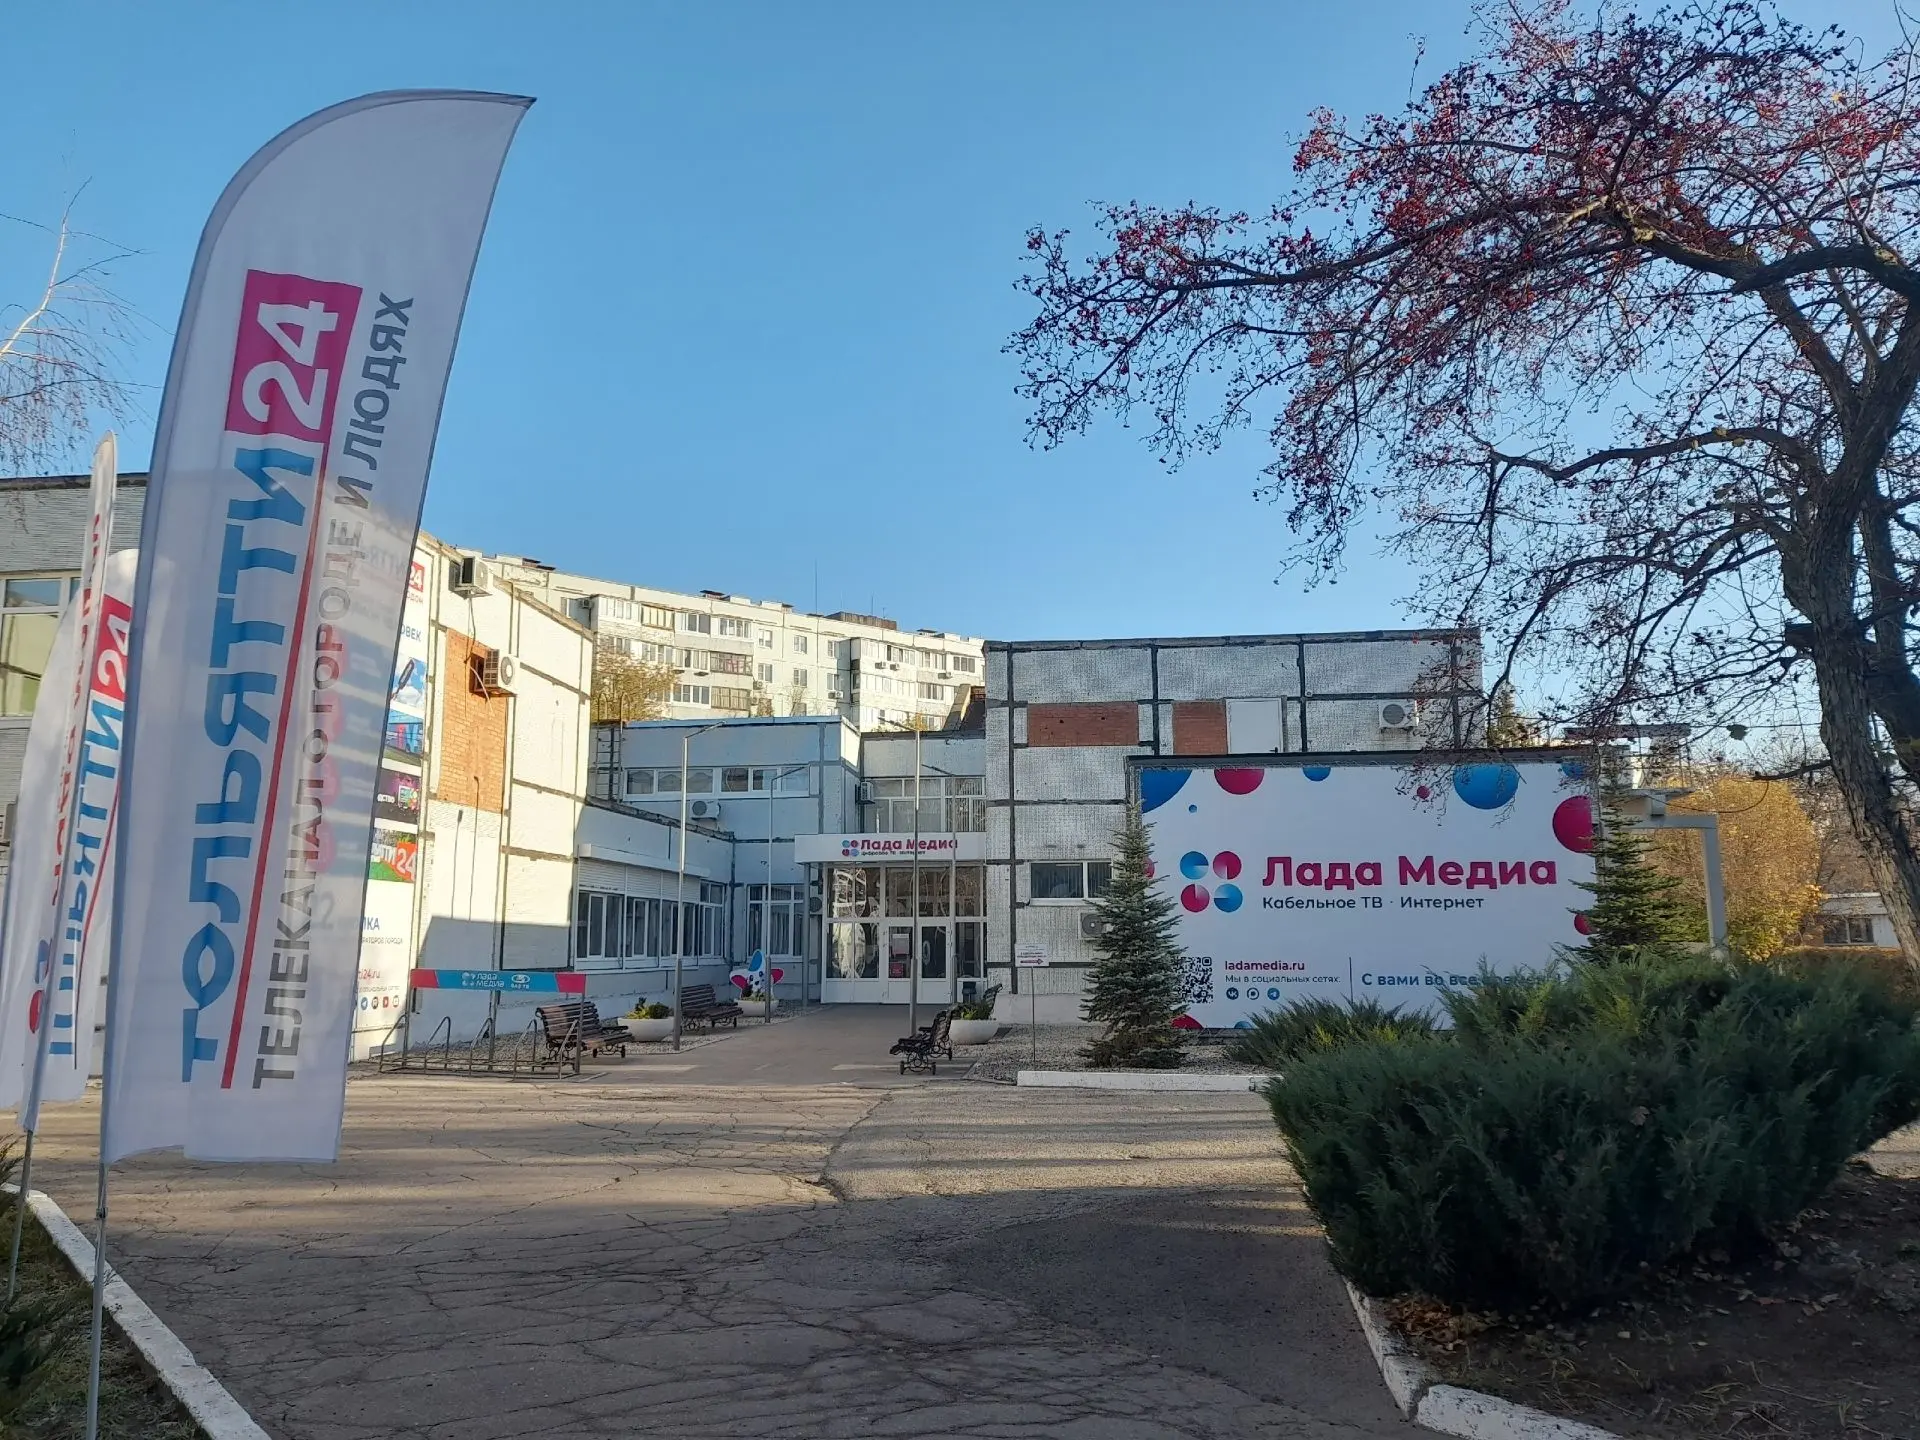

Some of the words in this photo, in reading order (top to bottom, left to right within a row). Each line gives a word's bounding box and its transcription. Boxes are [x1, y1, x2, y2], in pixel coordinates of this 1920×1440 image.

[343, 291, 414, 471] ЛЮДЯХ
[334, 475, 373, 510] И
[310, 518, 366, 714] ГОРОДЕ
[303, 728, 329, 764] О
[861, 839, 902, 851] Лада
[906, 838, 958, 851] Медиа
[1262, 856, 1383, 890] Лада
[1398, 855, 1557, 890] Медиа
[1262, 896, 1356, 910] Кабельное
[1361, 897, 1383, 908] ТВ
[1400, 896, 1485, 911] Интернет
[252, 778, 324, 1089] ТЕЛЕКАНАЛ
[1225, 960, 1305, 971] ladamedia.ru
[1251, 975, 1310, 984] социальных
[1361, 973, 1373, 985] С
[1377, 975, 1420, 986] вами
[1425, 976, 1445, 986] во
